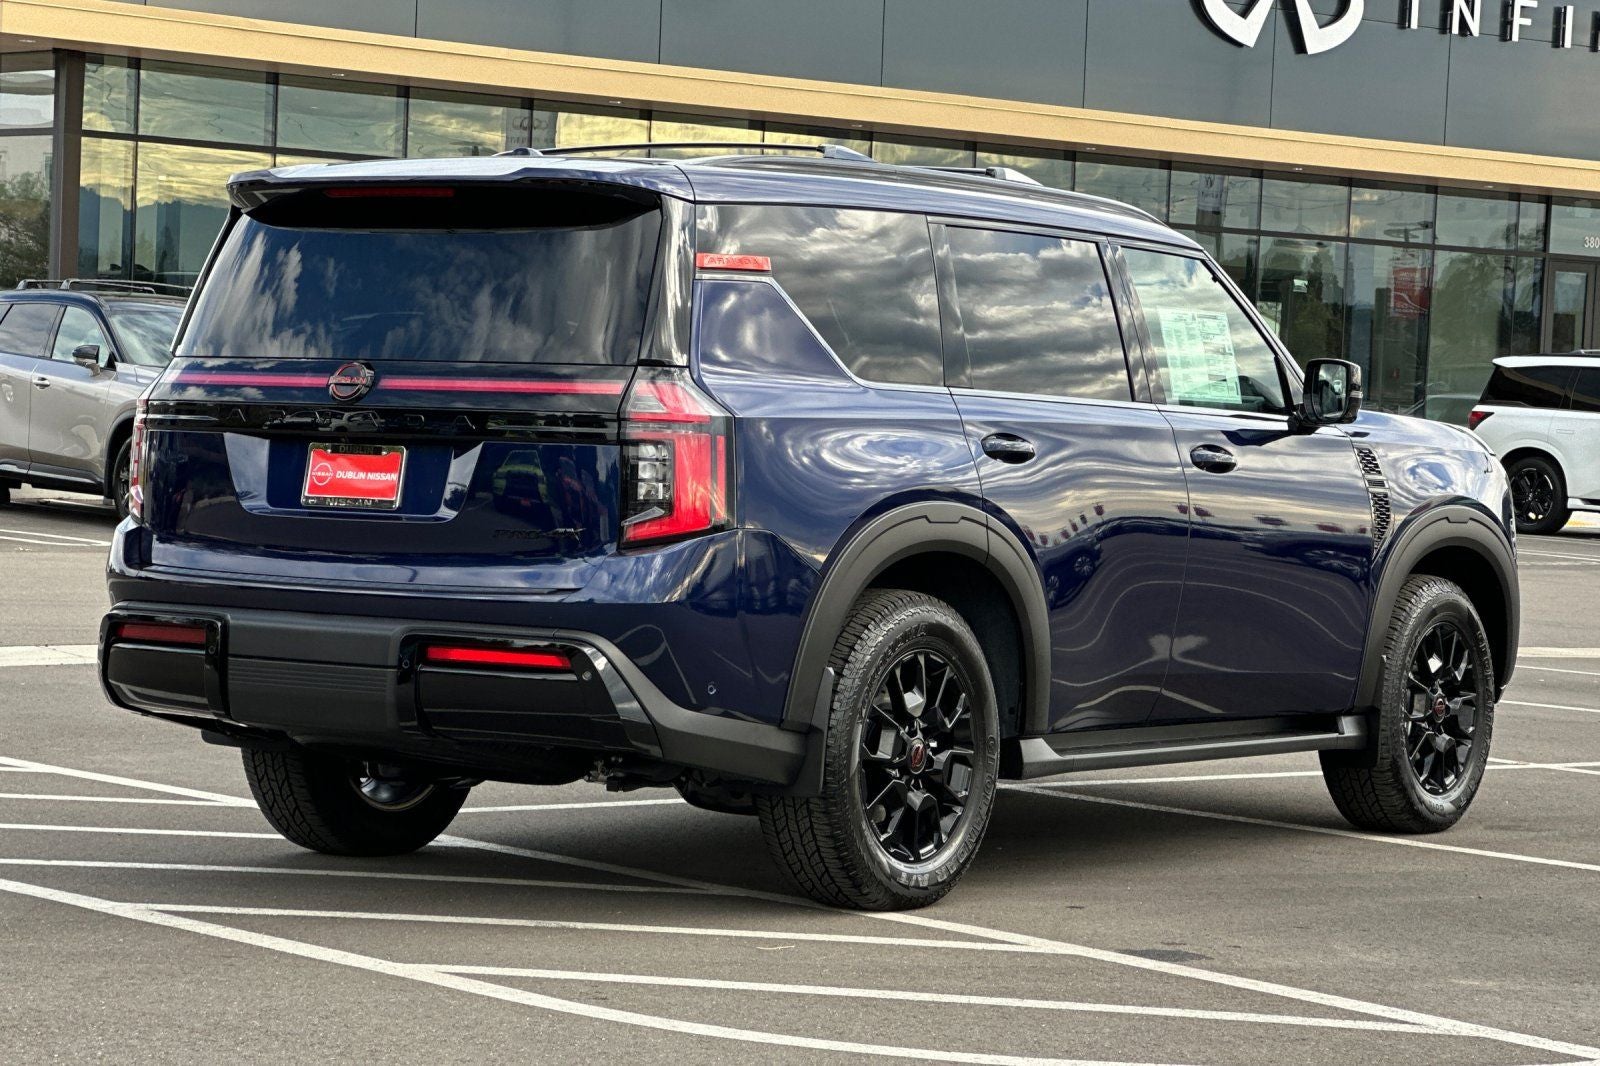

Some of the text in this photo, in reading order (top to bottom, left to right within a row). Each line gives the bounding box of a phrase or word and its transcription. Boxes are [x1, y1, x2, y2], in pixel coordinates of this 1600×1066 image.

[1410, 0, 1600, 51] INFI
[335, 470, 397, 481] DUBLIN NISSAN
